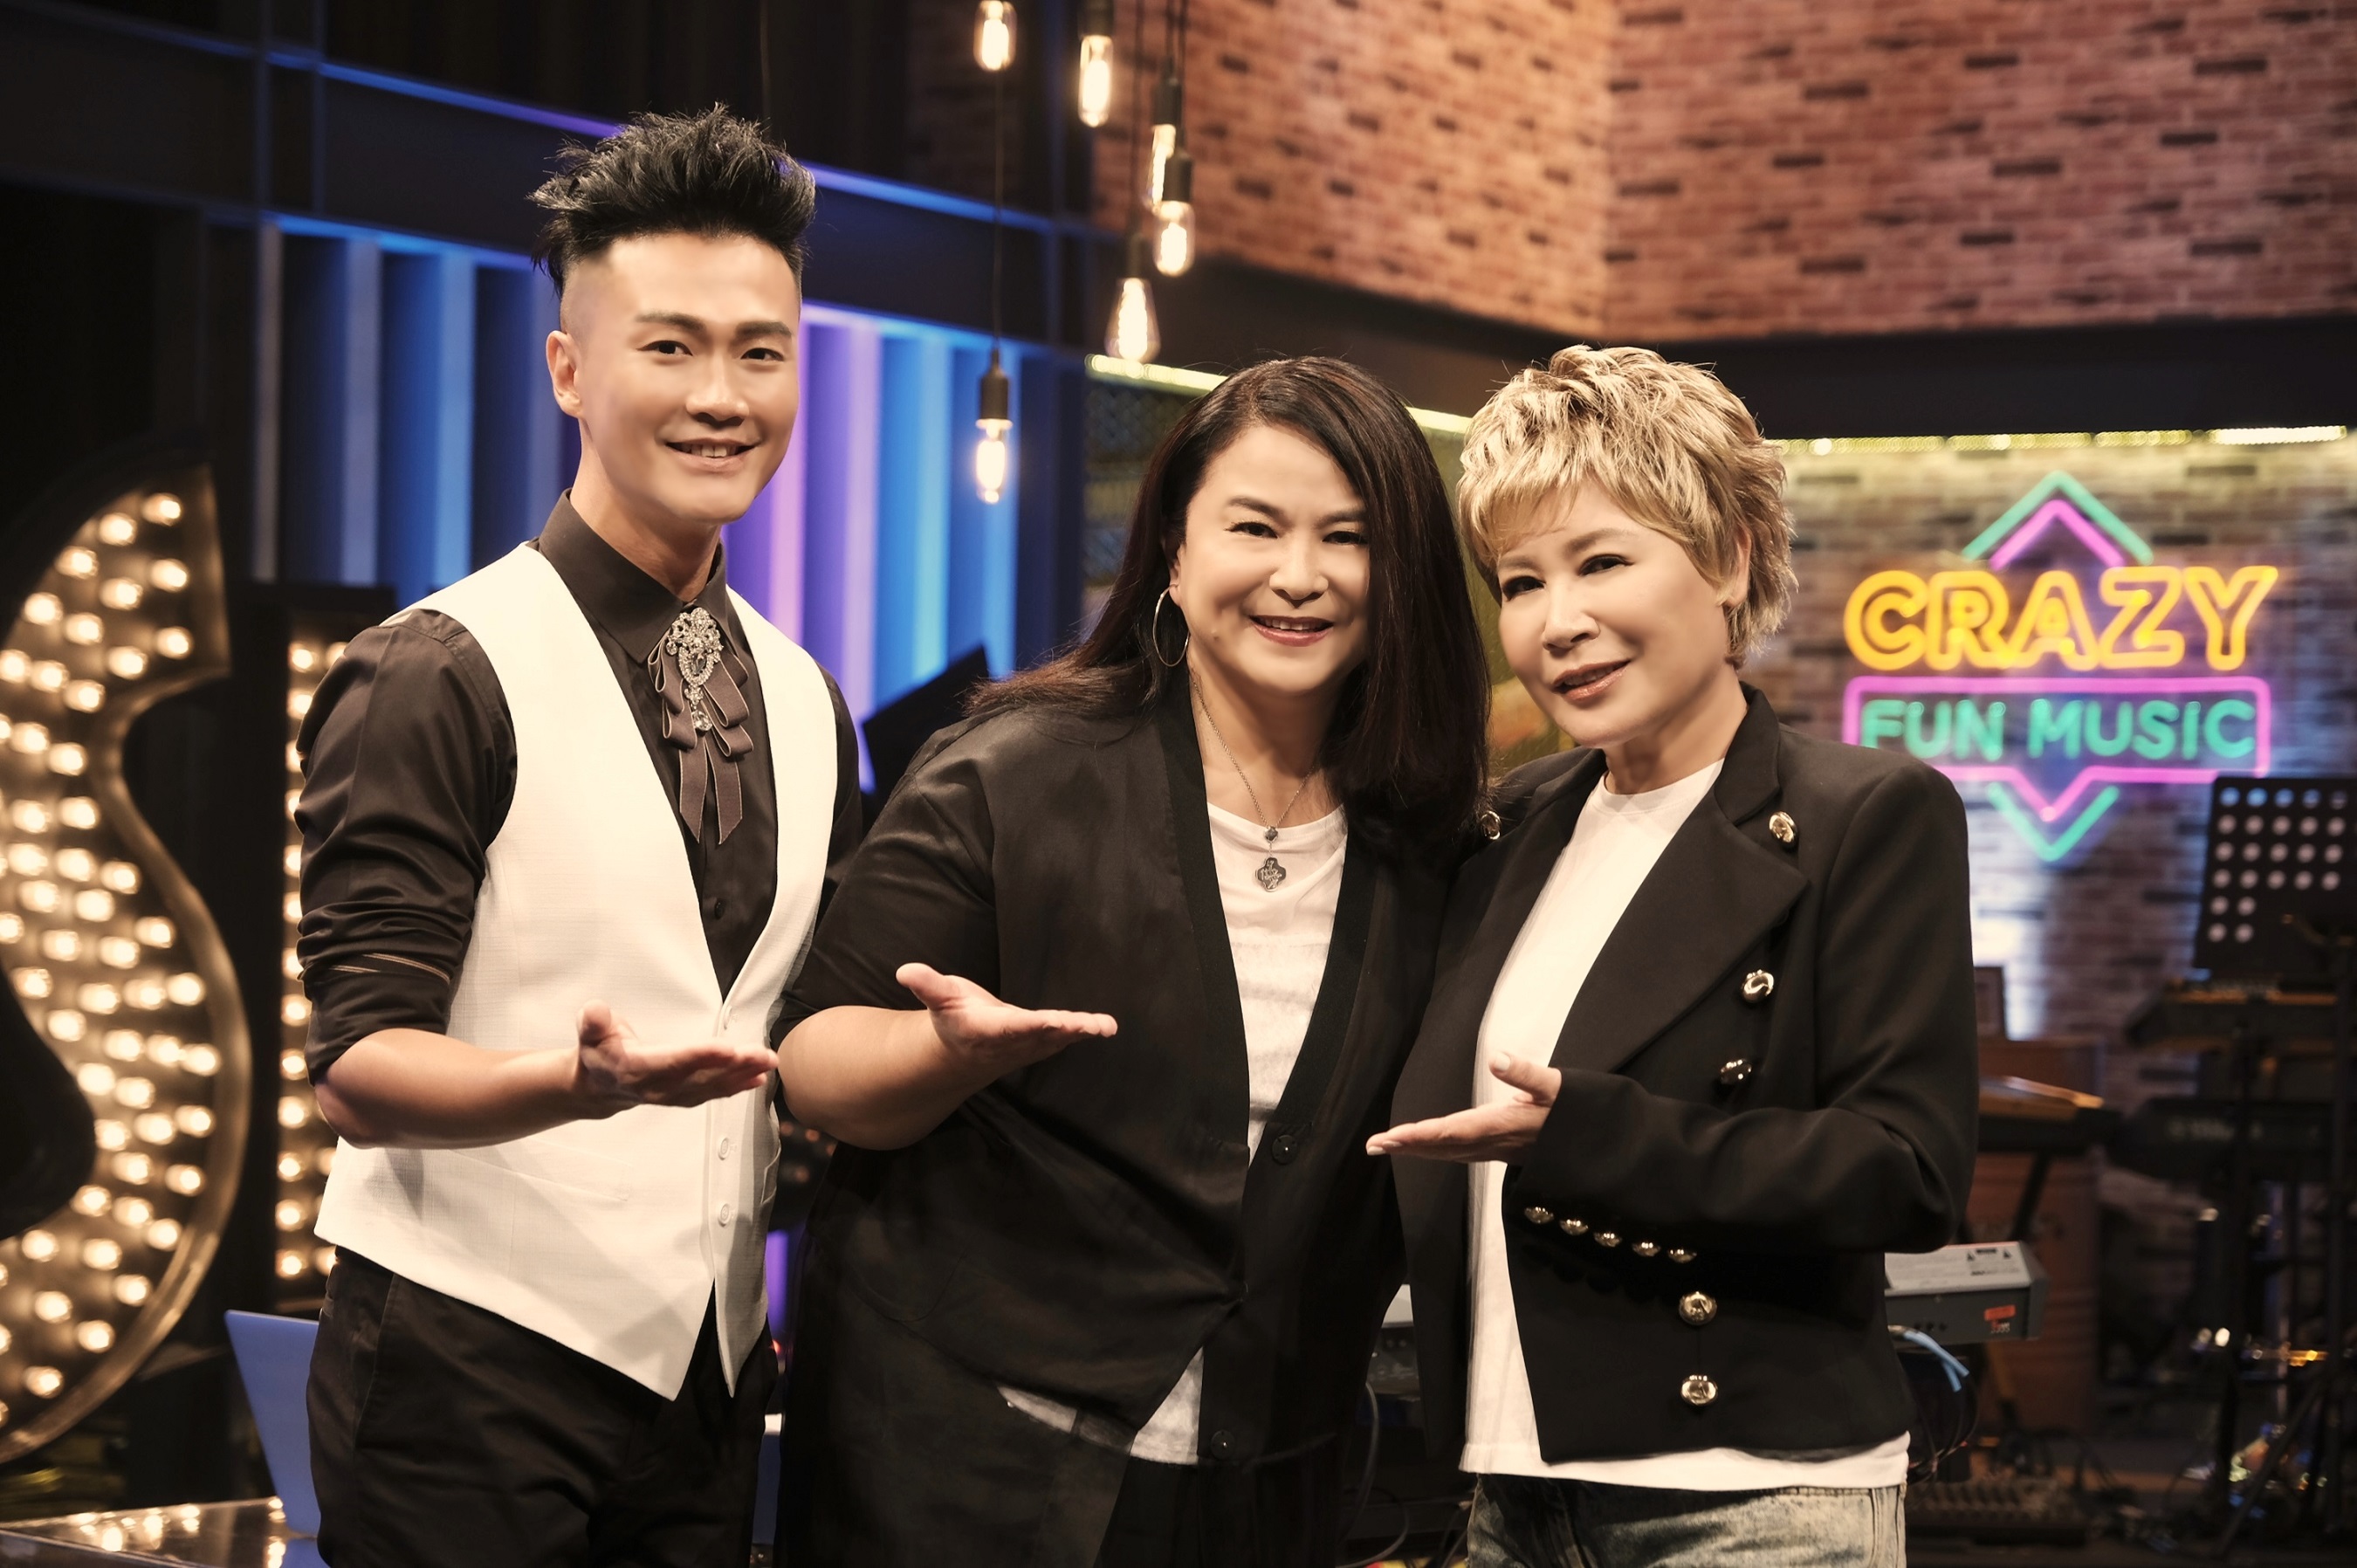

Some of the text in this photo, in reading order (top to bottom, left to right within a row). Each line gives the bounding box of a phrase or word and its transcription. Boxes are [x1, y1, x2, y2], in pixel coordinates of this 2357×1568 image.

[1844, 565, 2278, 671] CRAZY
[1860, 698, 2256, 760] FUN MUSIC
